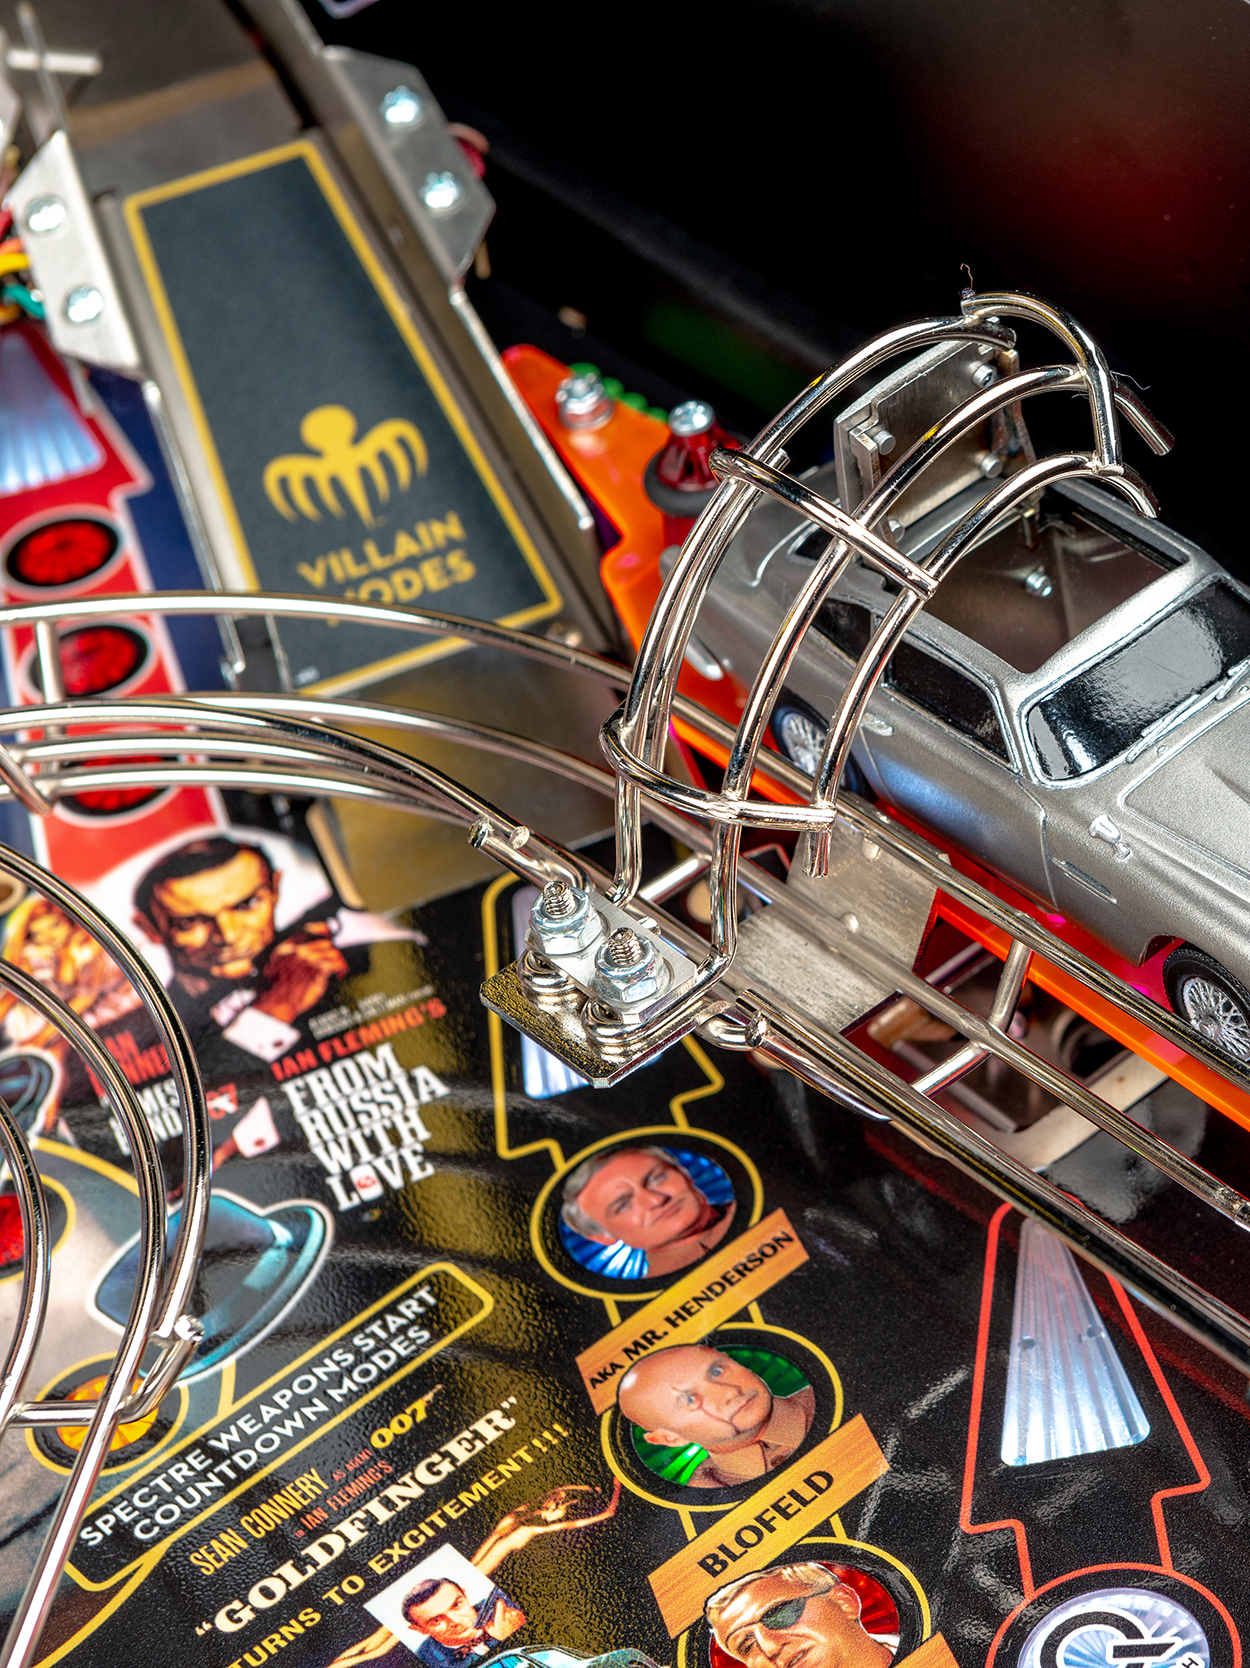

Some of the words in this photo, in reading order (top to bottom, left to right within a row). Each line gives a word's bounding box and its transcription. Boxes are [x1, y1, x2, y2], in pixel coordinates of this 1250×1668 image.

[296, 510, 466, 589] VILLAIN
[332, 549, 476, 614] ODES
[270, 1048, 318, 1081] IAN
[280, 1042, 408, 1117] FROM
[296, 1065, 450, 1148] RUSSIA
[309, 1106, 433, 1176] WITH
[589, 1362, 625, 1390] AKA
[621, 1328, 669, 1361] MR.
[663, 1230, 795, 1329] HENDERSON
[79, 1448, 213, 1547] SPECTRE
[207, 1348, 355, 1453] WEAPONS
[352, 1285, 441, 1353] START
[133, 1397, 329, 1540] COUNTDOWN
[329, 1325, 432, 1402] MODES
[189, 1527, 248, 1576] SEAN
[239, 1467, 329, 1540] CONNERY
[332, 1469, 347, 1483] AS
[345, 1448, 373, 1473] AGENT
[370, 1394, 433, 1450] 007
[300, 1507, 329, 1530] IAN
[326, 1460, 393, 1512] FLEMING'S
[696, 1469, 835, 1579] BLOFELD
[322, 1575, 365, 1606] TO
